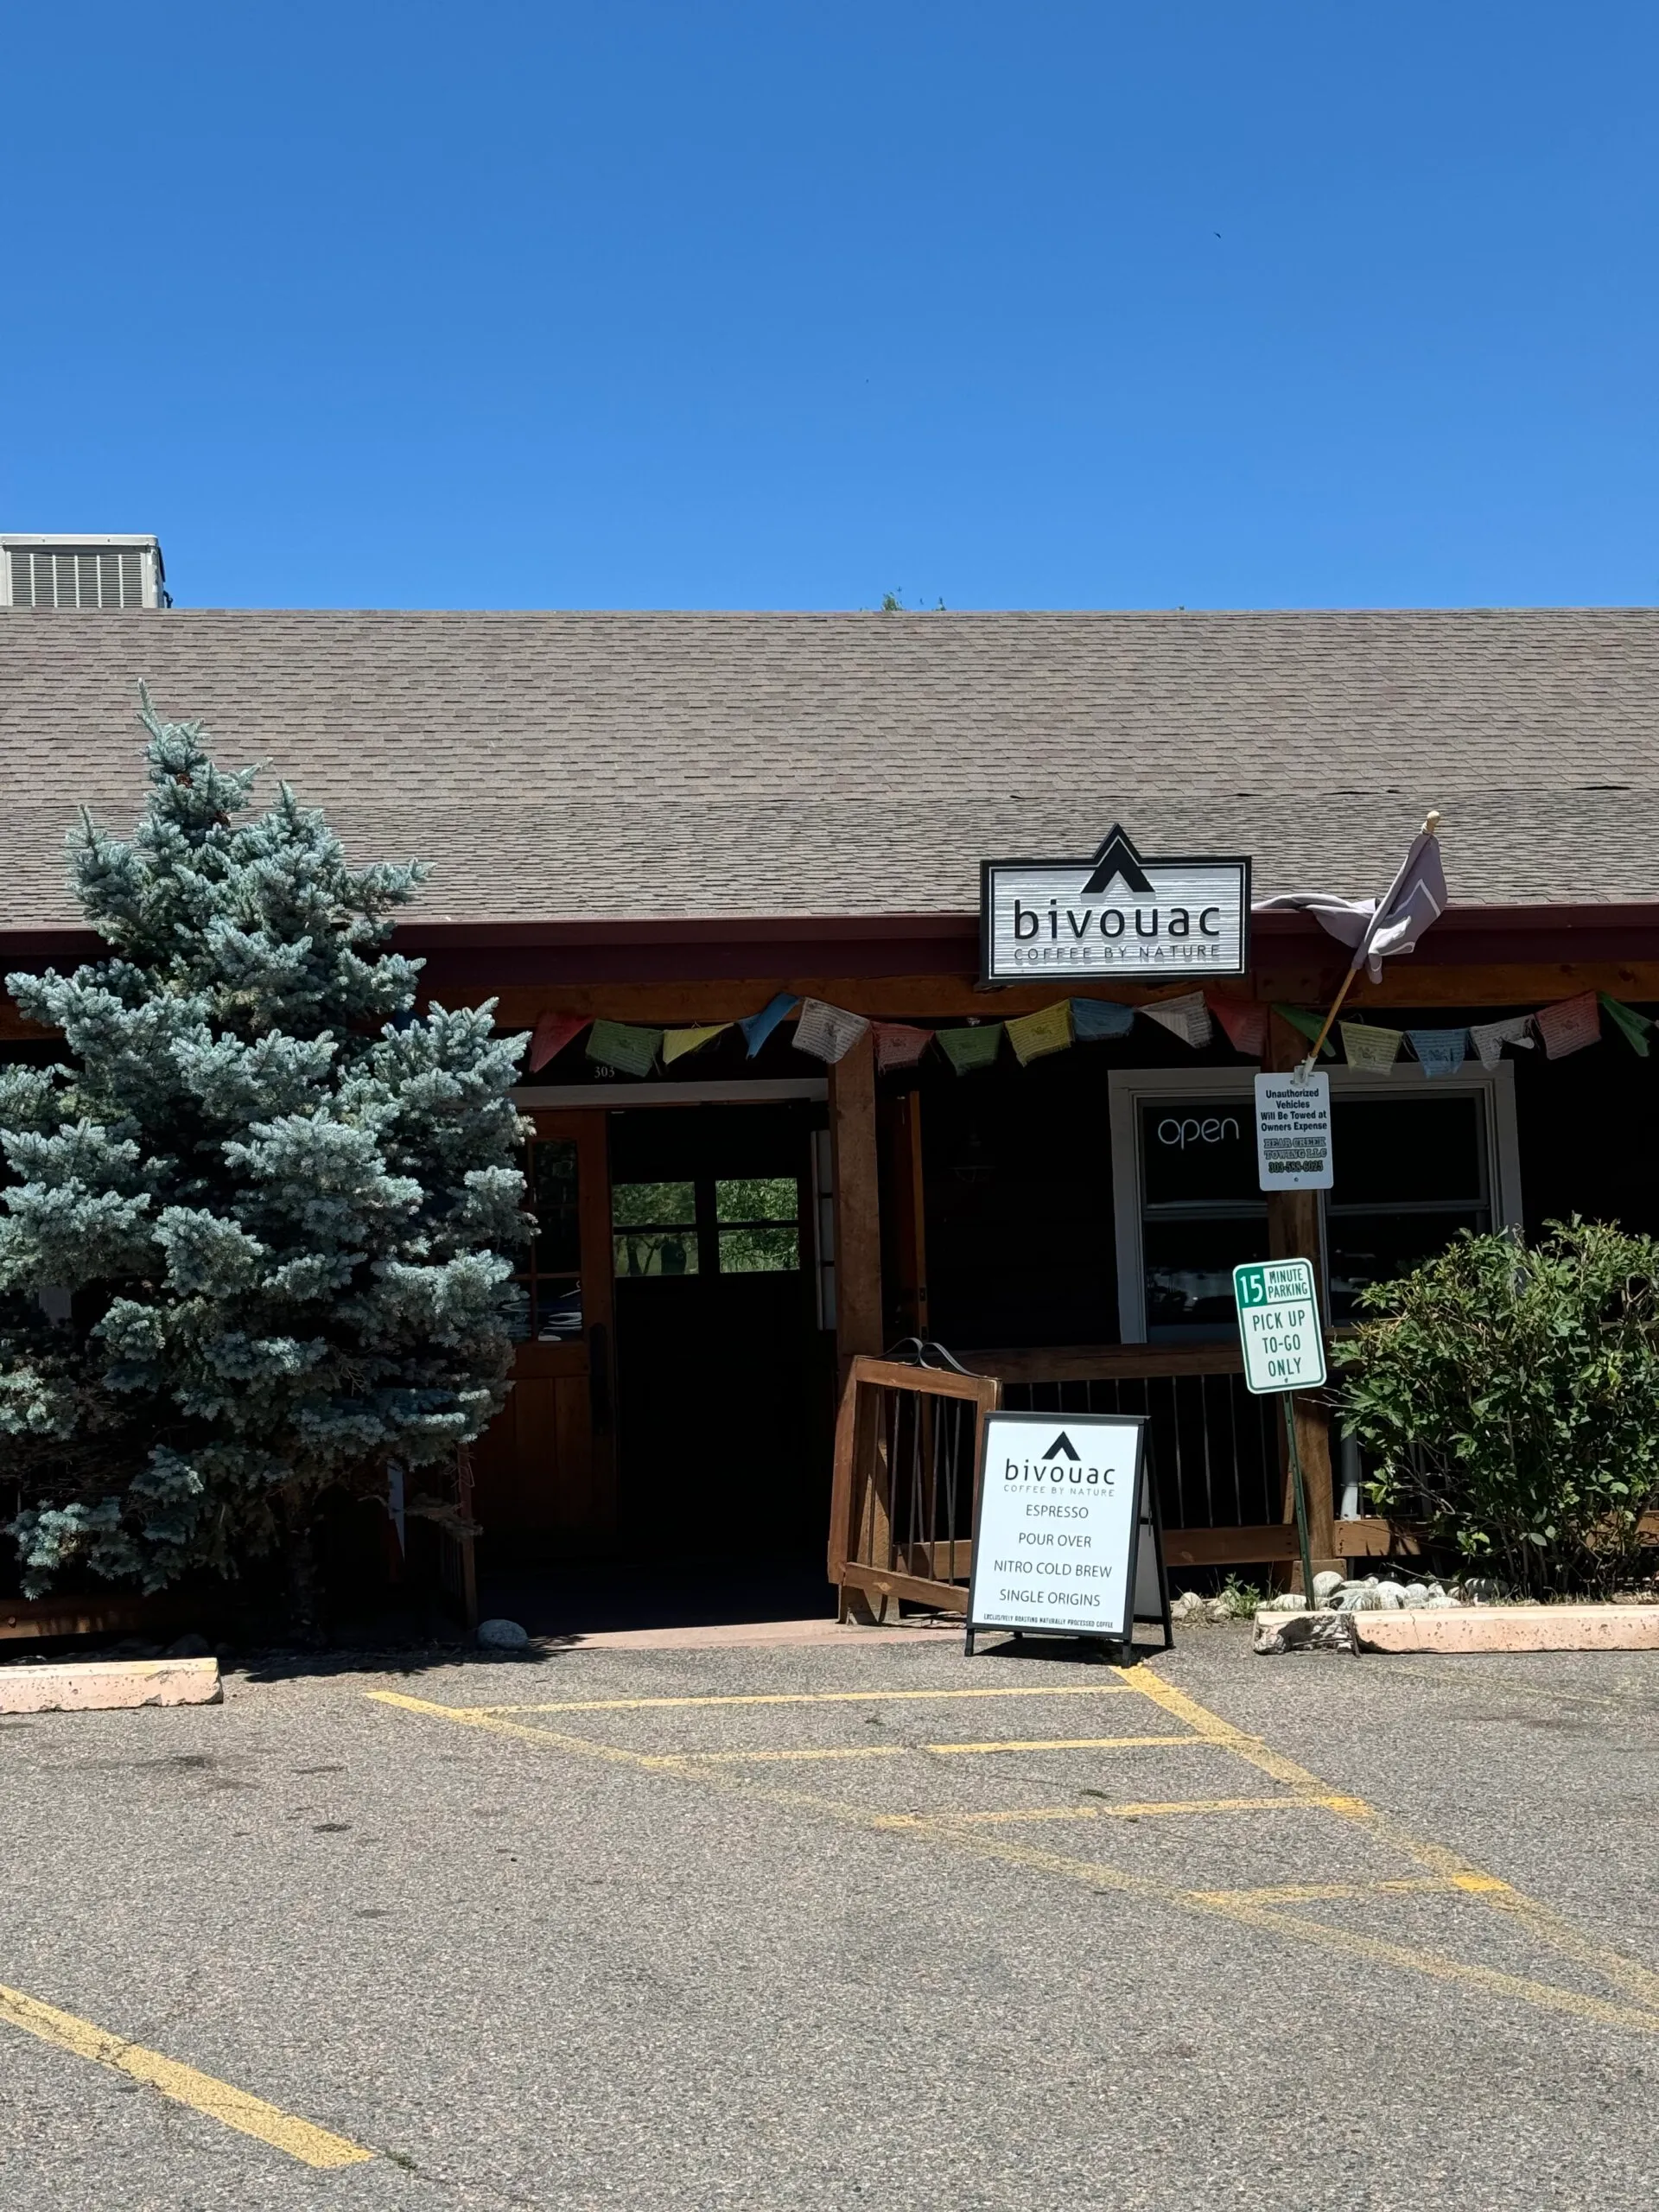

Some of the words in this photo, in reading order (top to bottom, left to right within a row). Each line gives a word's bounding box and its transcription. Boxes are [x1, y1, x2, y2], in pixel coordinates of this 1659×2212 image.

[1014, 899, 1220, 940] bivouac
[1014, 947, 1092, 961] COFFEE
[1104, 946, 1128, 959] BY
[1139, 944, 1220, 958] NATURE
[594, 1066, 615, 1078] 303
[1266, 1089, 1319, 1098] Unauthorized
[1261, 1111, 1275, 1121] Will
[1277, 1111, 1288, 1121] Be
[1290, 1110, 1316, 1120] Towed
[1318, 1110, 1327, 1119] at
[1158, 1117, 1240, 1150] open
[1261, 1122, 1292, 1132] Owners
[1294, 1122, 1327, 1132] Expense
[1264, 1139, 1292, 1148] BEAR
[1293, 1137, 1326, 1147] CREEK
[1264, 1150, 1305, 1160] TOWING
[1306, 1148, 1327, 1158] LLC
[1268, 1268, 1304, 1284] MINUTE
[1239, 1274, 1263, 1304] 15
[1268, 1282, 1308, 1299] PARKING
[1252, 1312, 1283, 1332] PICK
[1287, 1309, 1306, 1327] UP
[1262, 1333, 1301, 1354] TO-GO
[1268, 1357, 1302, 1377] ONLY
[1005, 1458, 1116, 1485] bivouac
[1003, 1484, 1046, 1493] COFFEE
[1051, 1486, 1065, 1495] BY
[1070, 1487, 1115, 1497] NATURE
[1026, 1504, 1089, 1519] ESPRESSO
[1018, 1532, 1054, 1547] POUR
[1057, 1534, 1092, 1548] OVER
[994, 1560, 1033, 1573] NITRO
[1036, 1561, 1072, 1576] COLD
[1076, 1564, 1112, 1578] BREW
[999, 1588, 1045, 1603] SINGLE
[1047, 1591, 1101, 1607] ORIGINS
[983, 1613, 1014, 1622] EXCLUSIVELY
[1039, 1617, 1066, 1625] NATURALLY
[1067, 1618, 1095, 1627] PROCESSED
[1096, 1620, 1114, 1629] COFFEE
